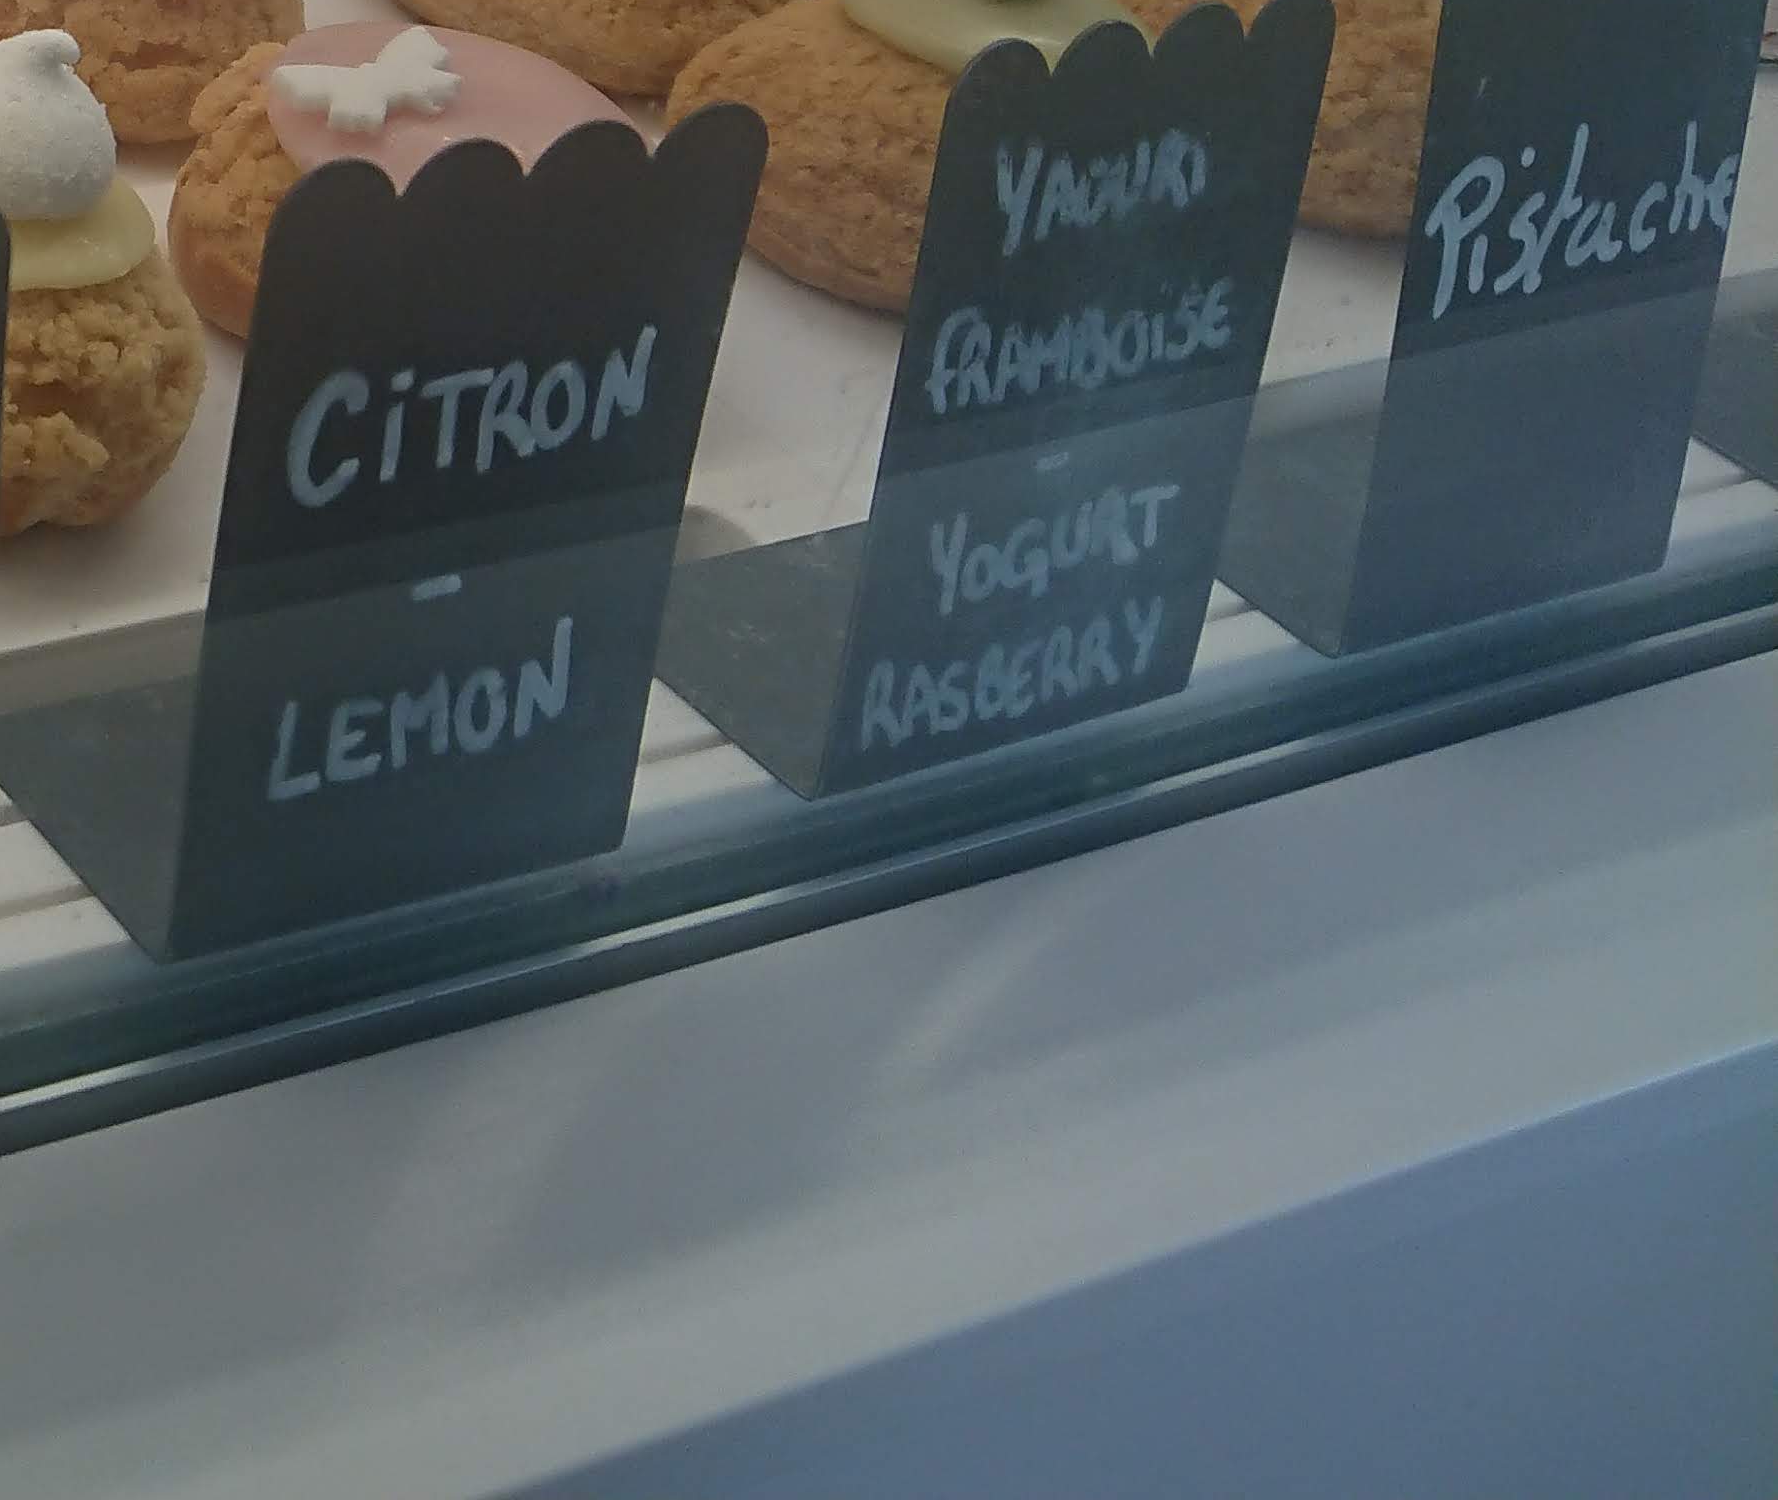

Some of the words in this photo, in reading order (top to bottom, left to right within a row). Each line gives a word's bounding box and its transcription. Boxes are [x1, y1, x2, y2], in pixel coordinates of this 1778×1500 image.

[1424, 121, 1742, 320] Pistache
[930, 485, 1181, 617] YOGURT
[267, 616, 573, 802] LEMON
[860, 596, 1165, 751] RASBERRY
